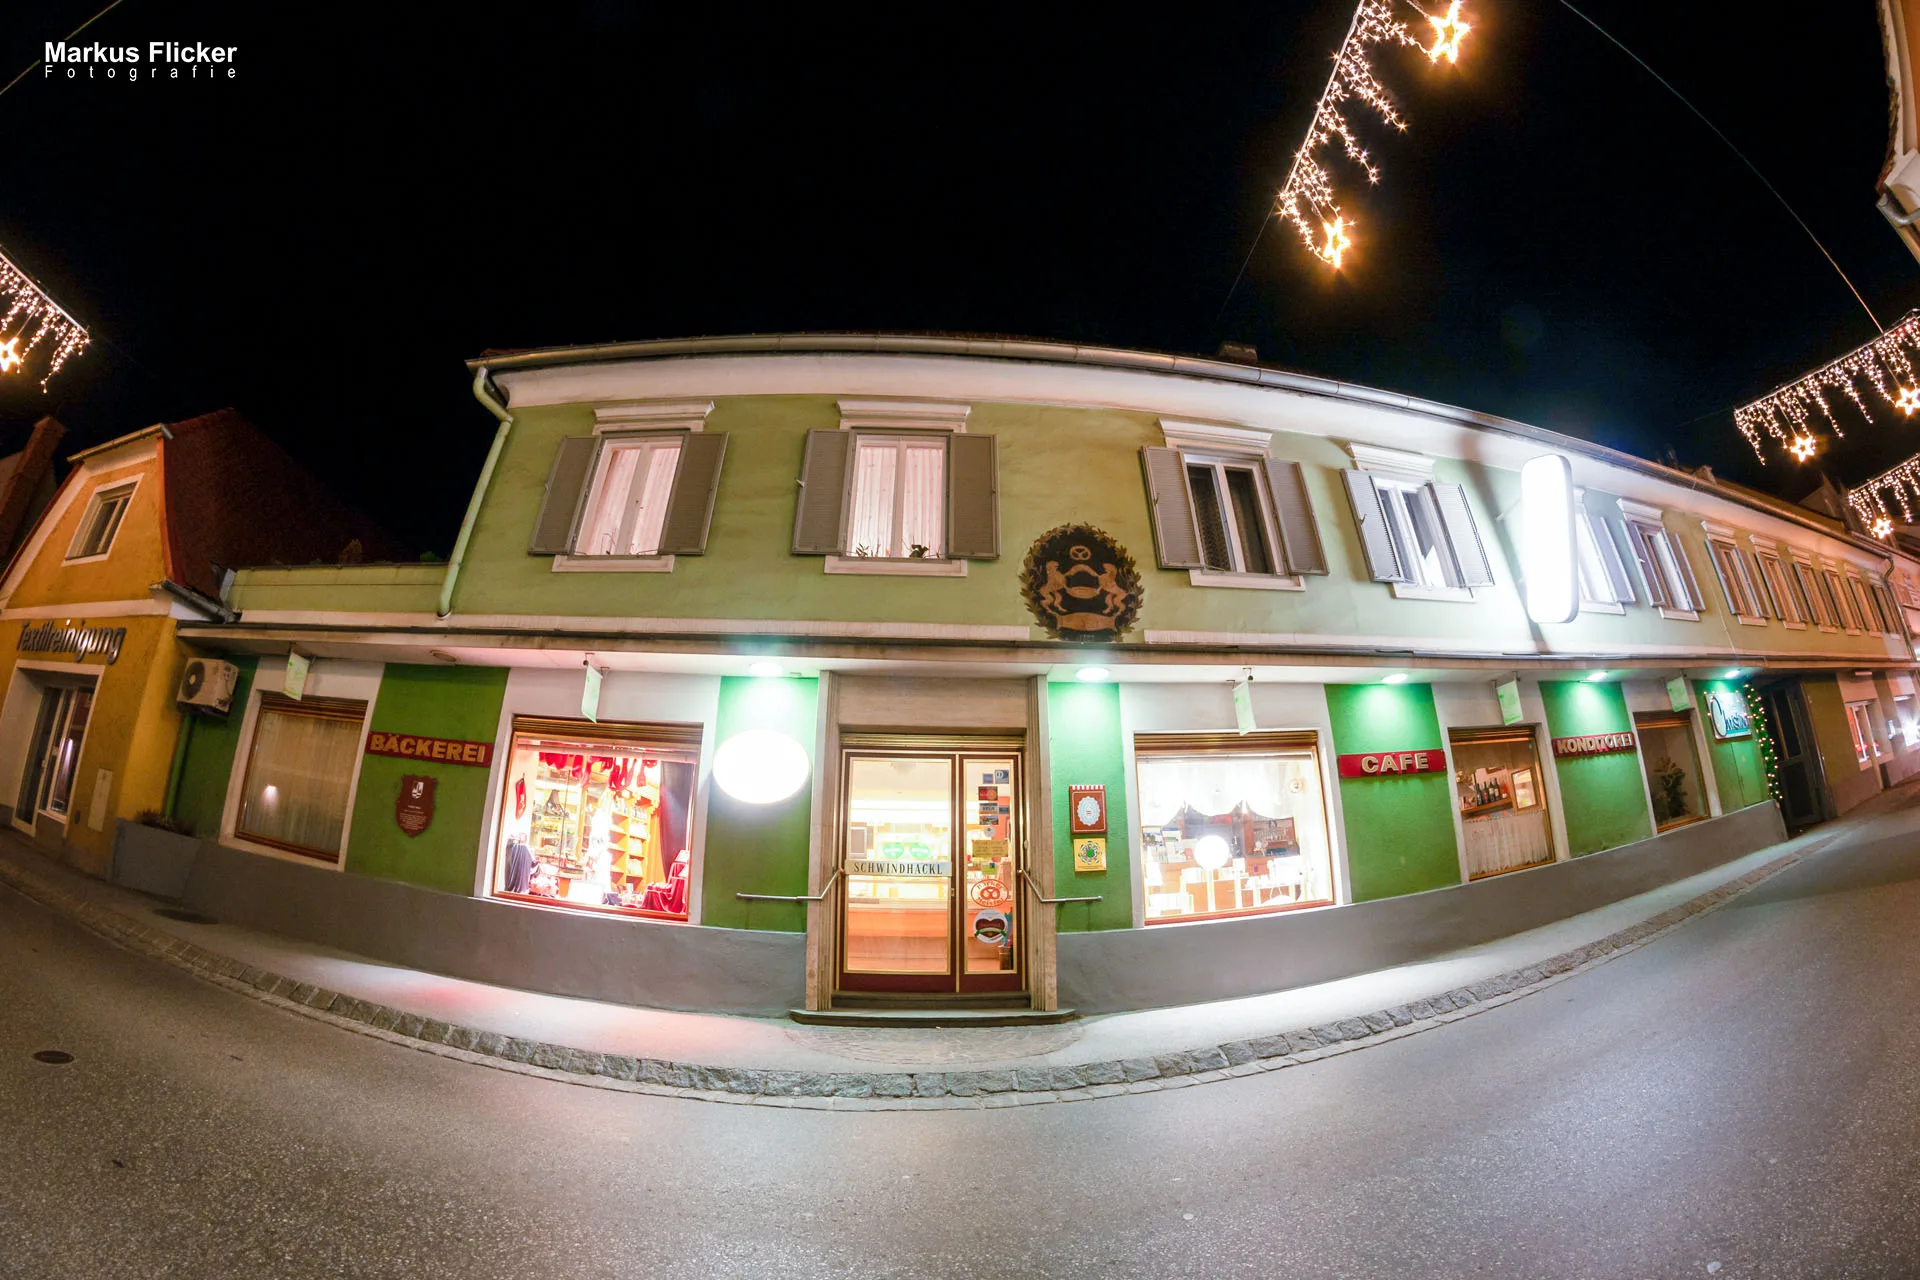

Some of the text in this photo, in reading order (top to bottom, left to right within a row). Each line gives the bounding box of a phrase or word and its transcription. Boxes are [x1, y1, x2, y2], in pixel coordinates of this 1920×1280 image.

[16, 619, 127, 666] Textilreinigung
[370, 734, 486, 763] BÄCKEREI
[1557, 733, 1633, 754] KONDITOREI
[1361, 752, 1429, 773] CAFE
[854, 862, 943, 875] SCHWINDHACKL
